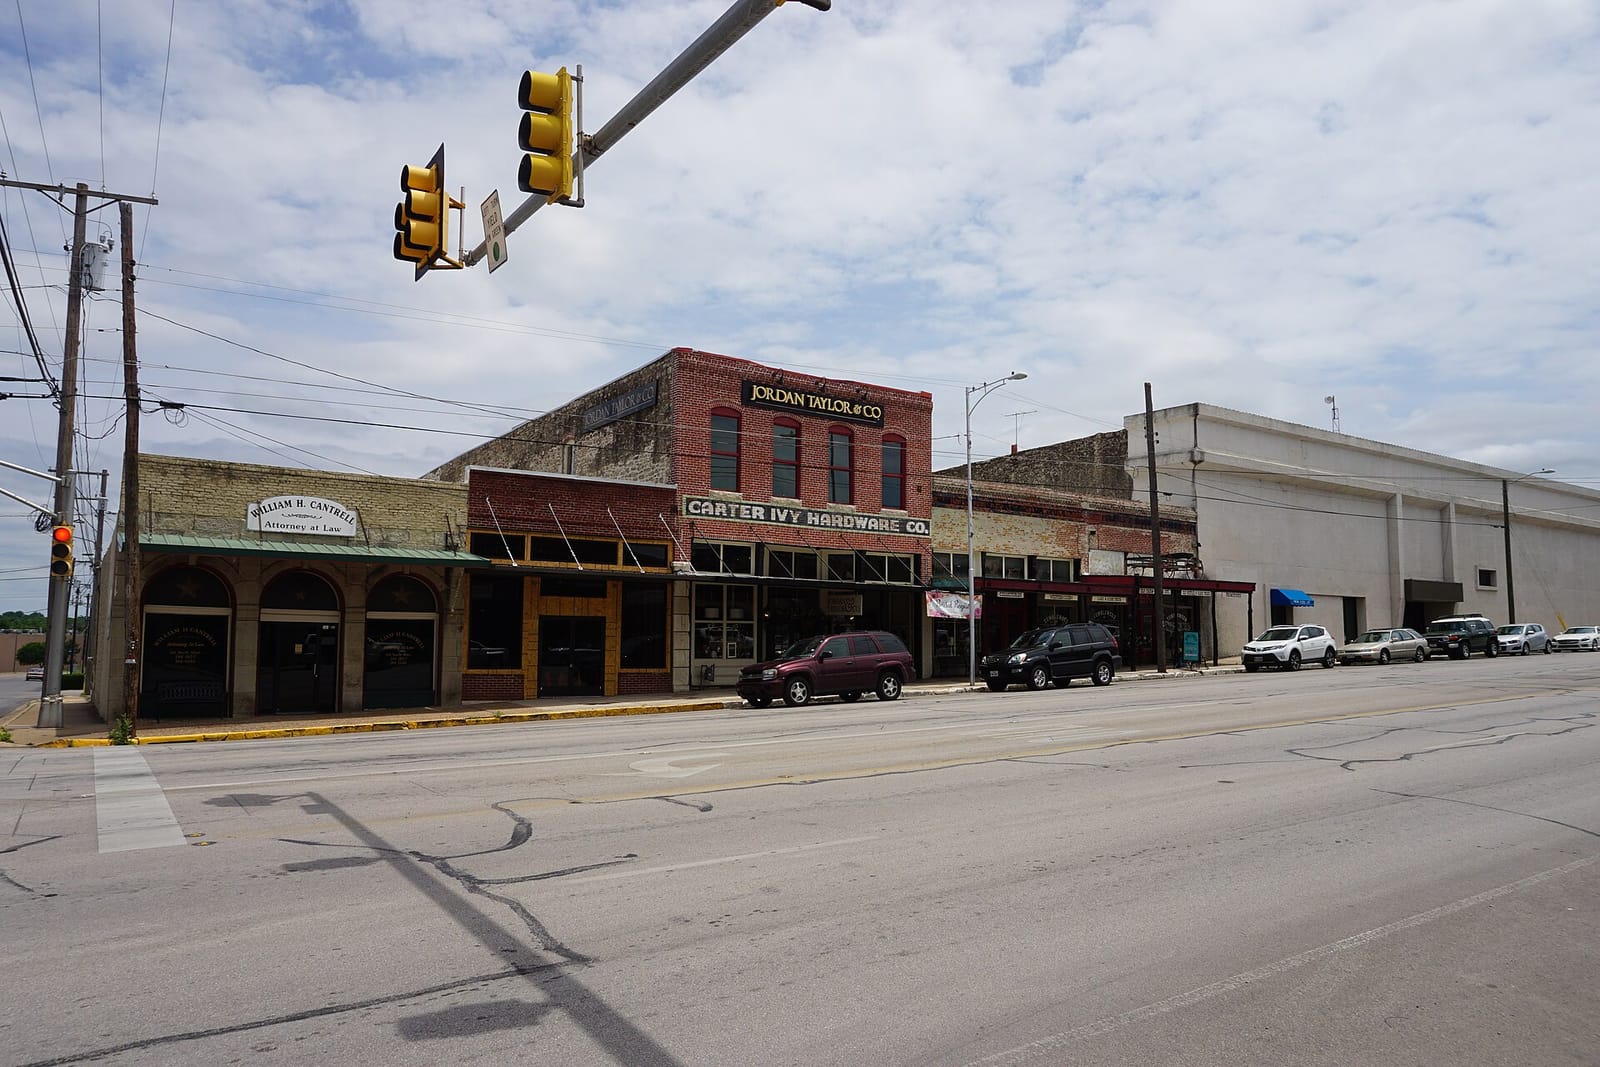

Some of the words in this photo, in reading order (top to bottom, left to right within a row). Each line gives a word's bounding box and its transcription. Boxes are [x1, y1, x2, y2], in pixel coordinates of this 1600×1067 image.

[751, 385, 805, 407] JORDAN
[807, 394, 853, 415] TAYLOR
[853, 404, 863, 415] &
[250, 500, 292, 518] WILLIAM
[296, 499, 306, 508] H.
[310, 500, 355, 525] CANTRELL
[688, 500, 766, 520] CARTER
[771, 508, 800, 524] IVY
[807, 512, 900, 532] HARDWARE
[906, 521, 929, 534] CO.
[264, 521, 307, 532] Attorney
[323, 525, 342, 533] Law
